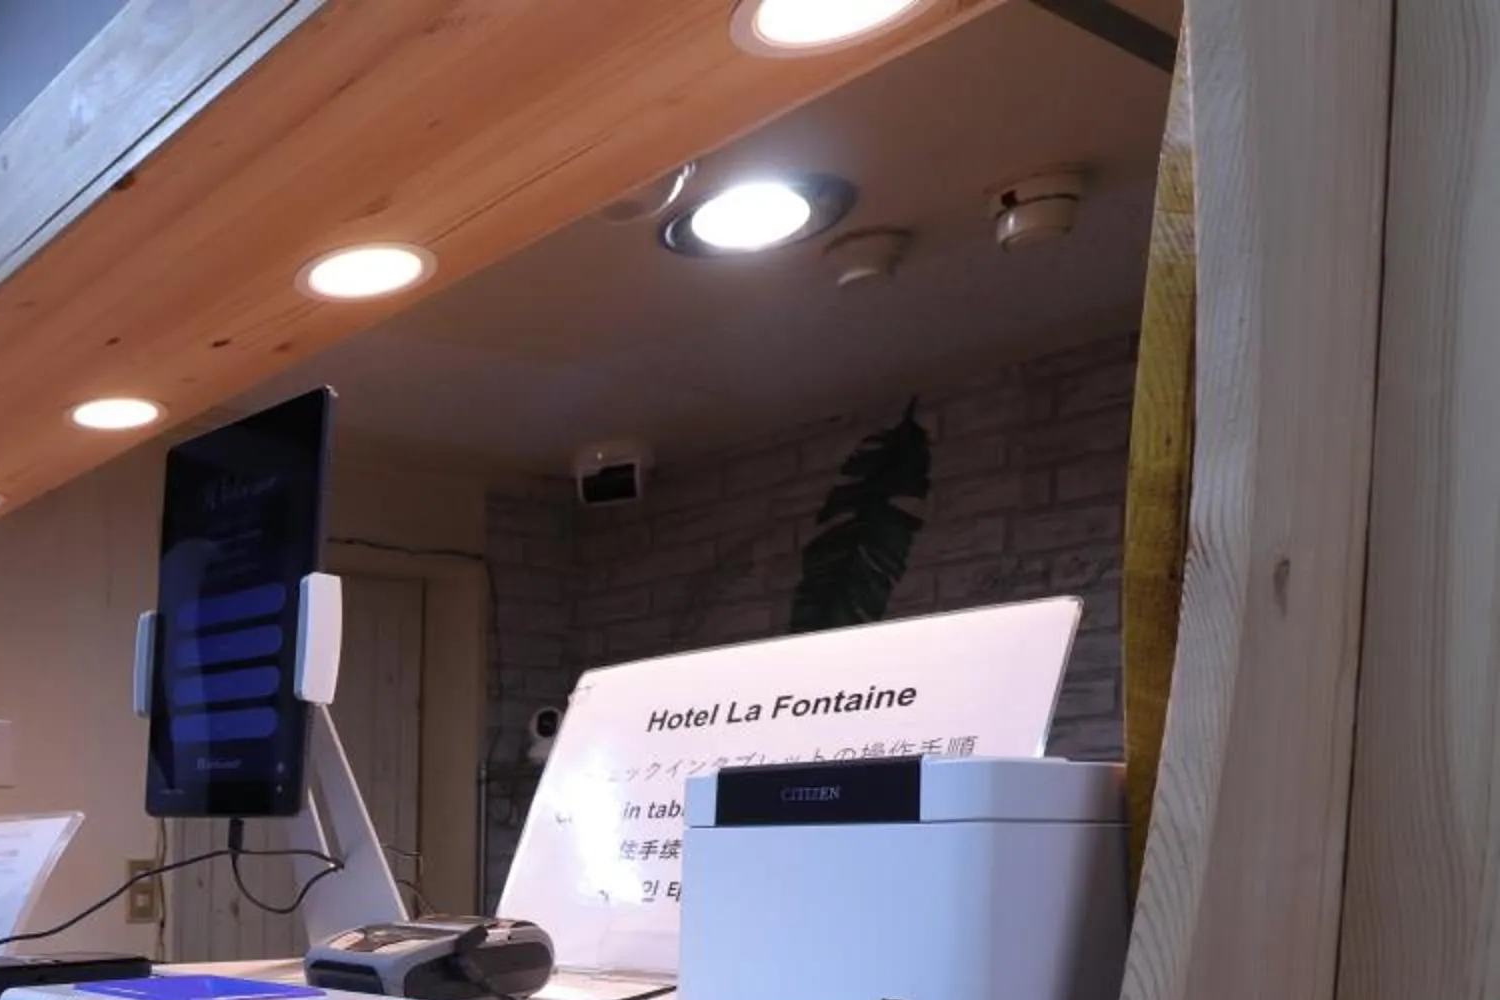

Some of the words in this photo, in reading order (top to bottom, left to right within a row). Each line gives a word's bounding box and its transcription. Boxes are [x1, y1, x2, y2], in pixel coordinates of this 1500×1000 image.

[646, 703, 720, 733] Hotel
[726, 700, 763, 724] La
[771, 684, 918, 720] Fontaine
[780, 785, 841, 802] CITIZEN
[647, 798, 685, 820] tab
